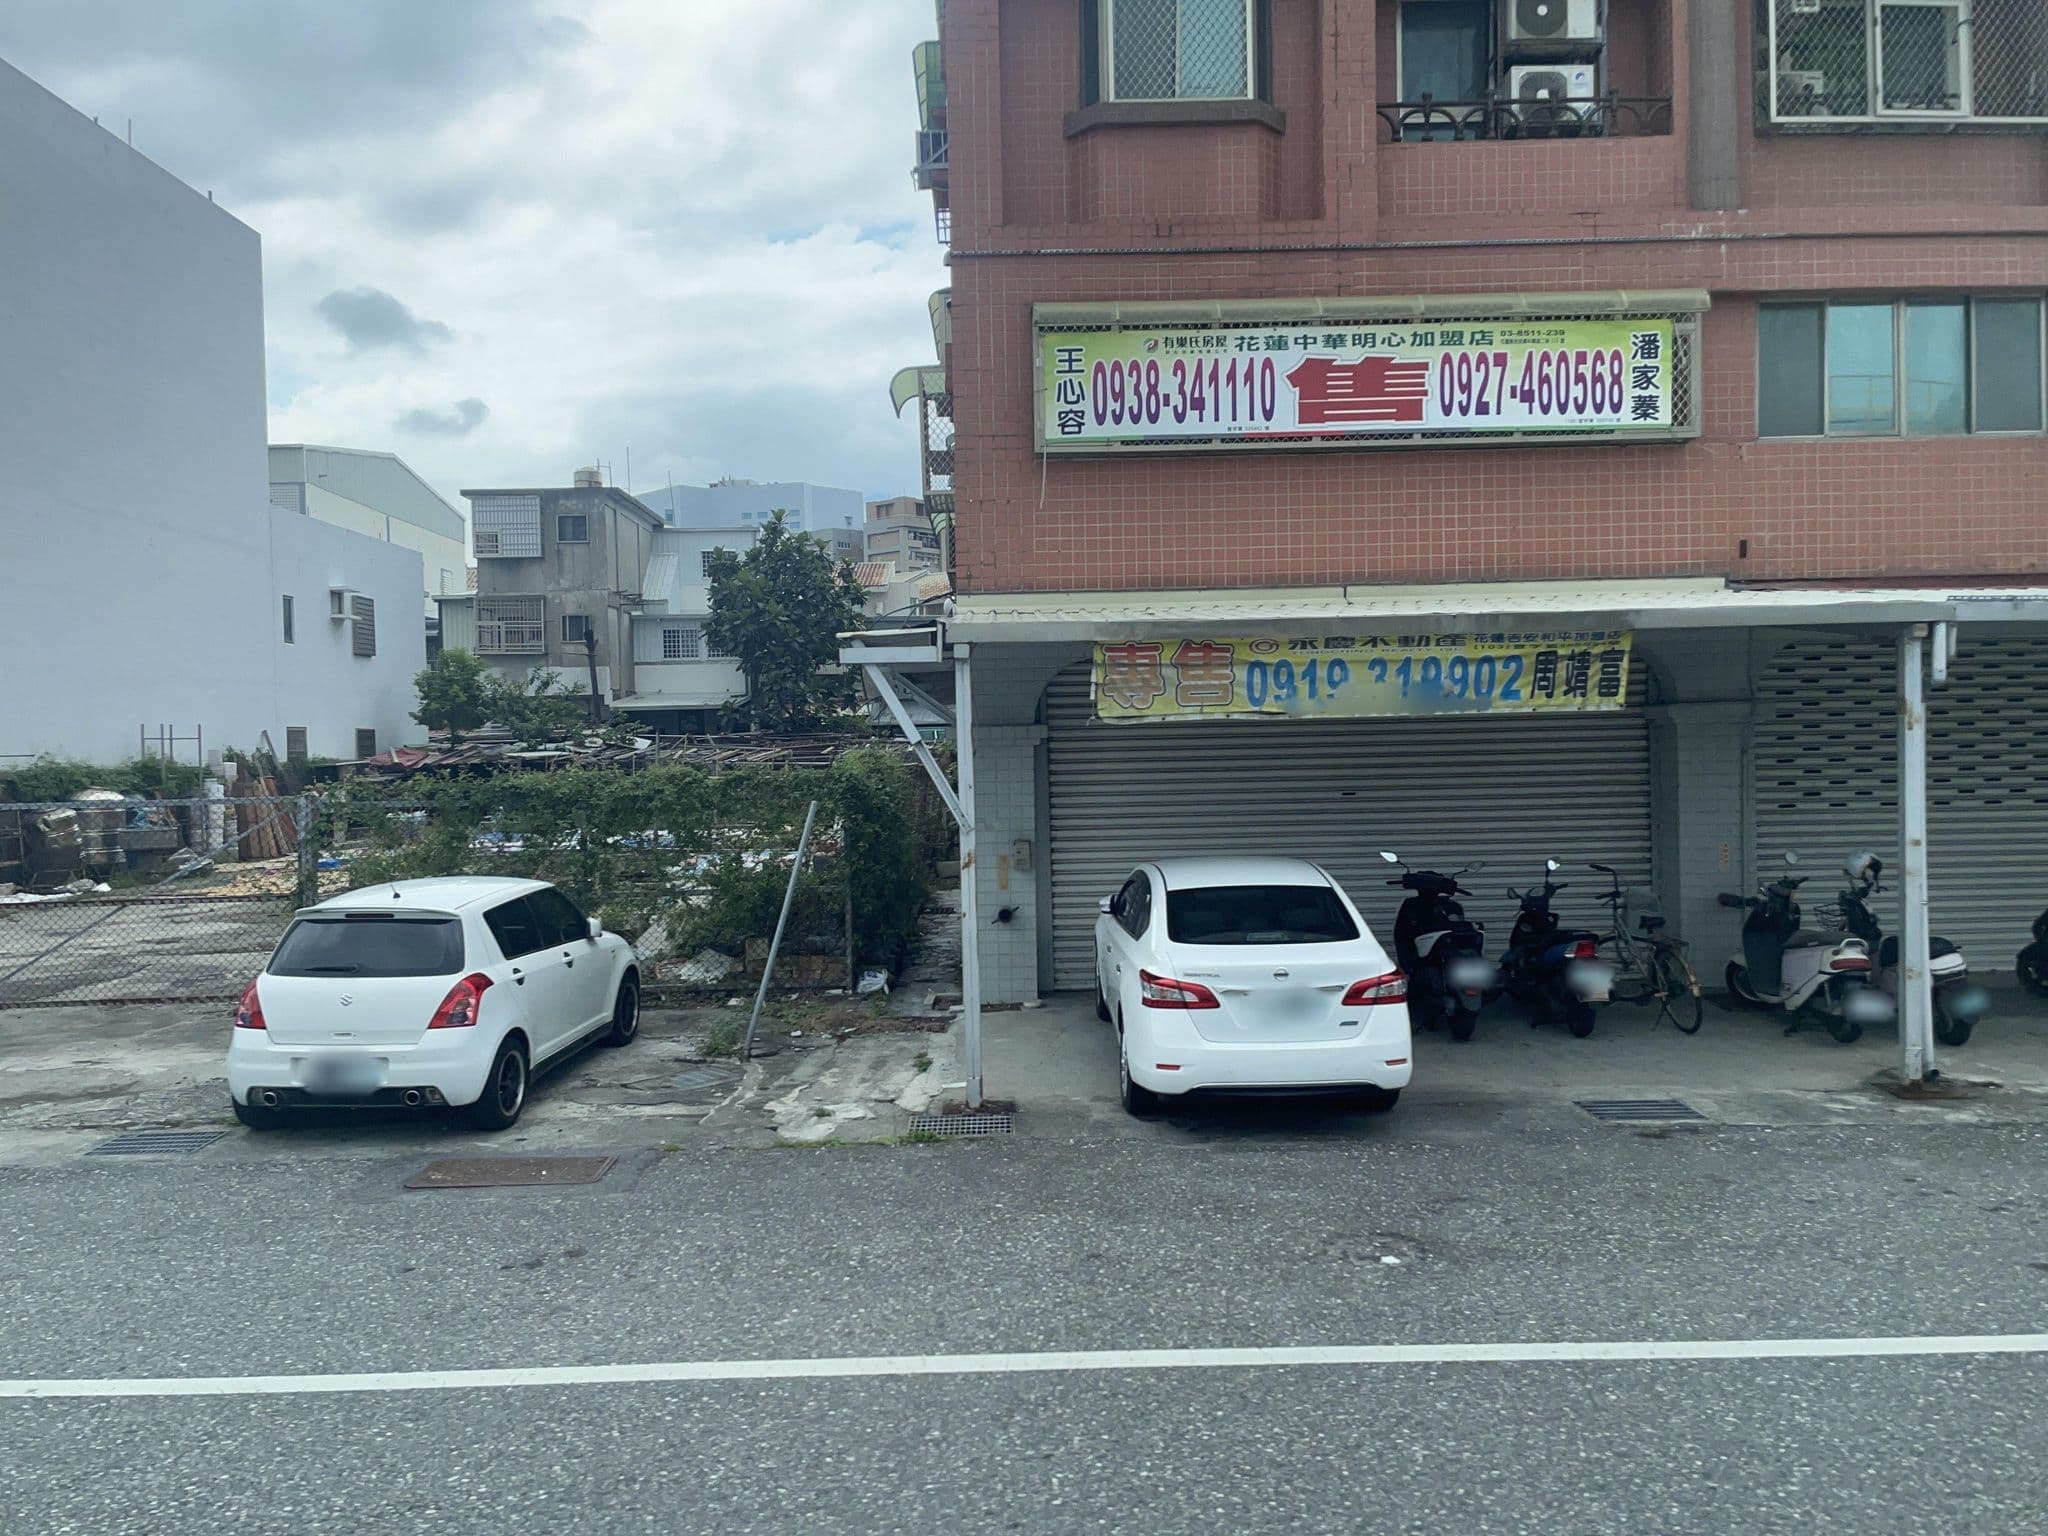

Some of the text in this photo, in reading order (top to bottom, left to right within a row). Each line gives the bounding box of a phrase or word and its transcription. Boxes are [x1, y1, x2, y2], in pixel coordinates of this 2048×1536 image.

[1162, 329, 1494, 352] 有巢氏房屋 花蓮中華明心加盟店
[1055, 347, 1086, 435] 王心容
[1092, 356, 1277, 425] 0938-341110
[1286, 356, 1430, 424] 售
[1440, 350, 1623, 417] 0927-460568
[1631, 333, 1660, 421] 潘家蓁
[1102, 639, 1235, 710] 專售
